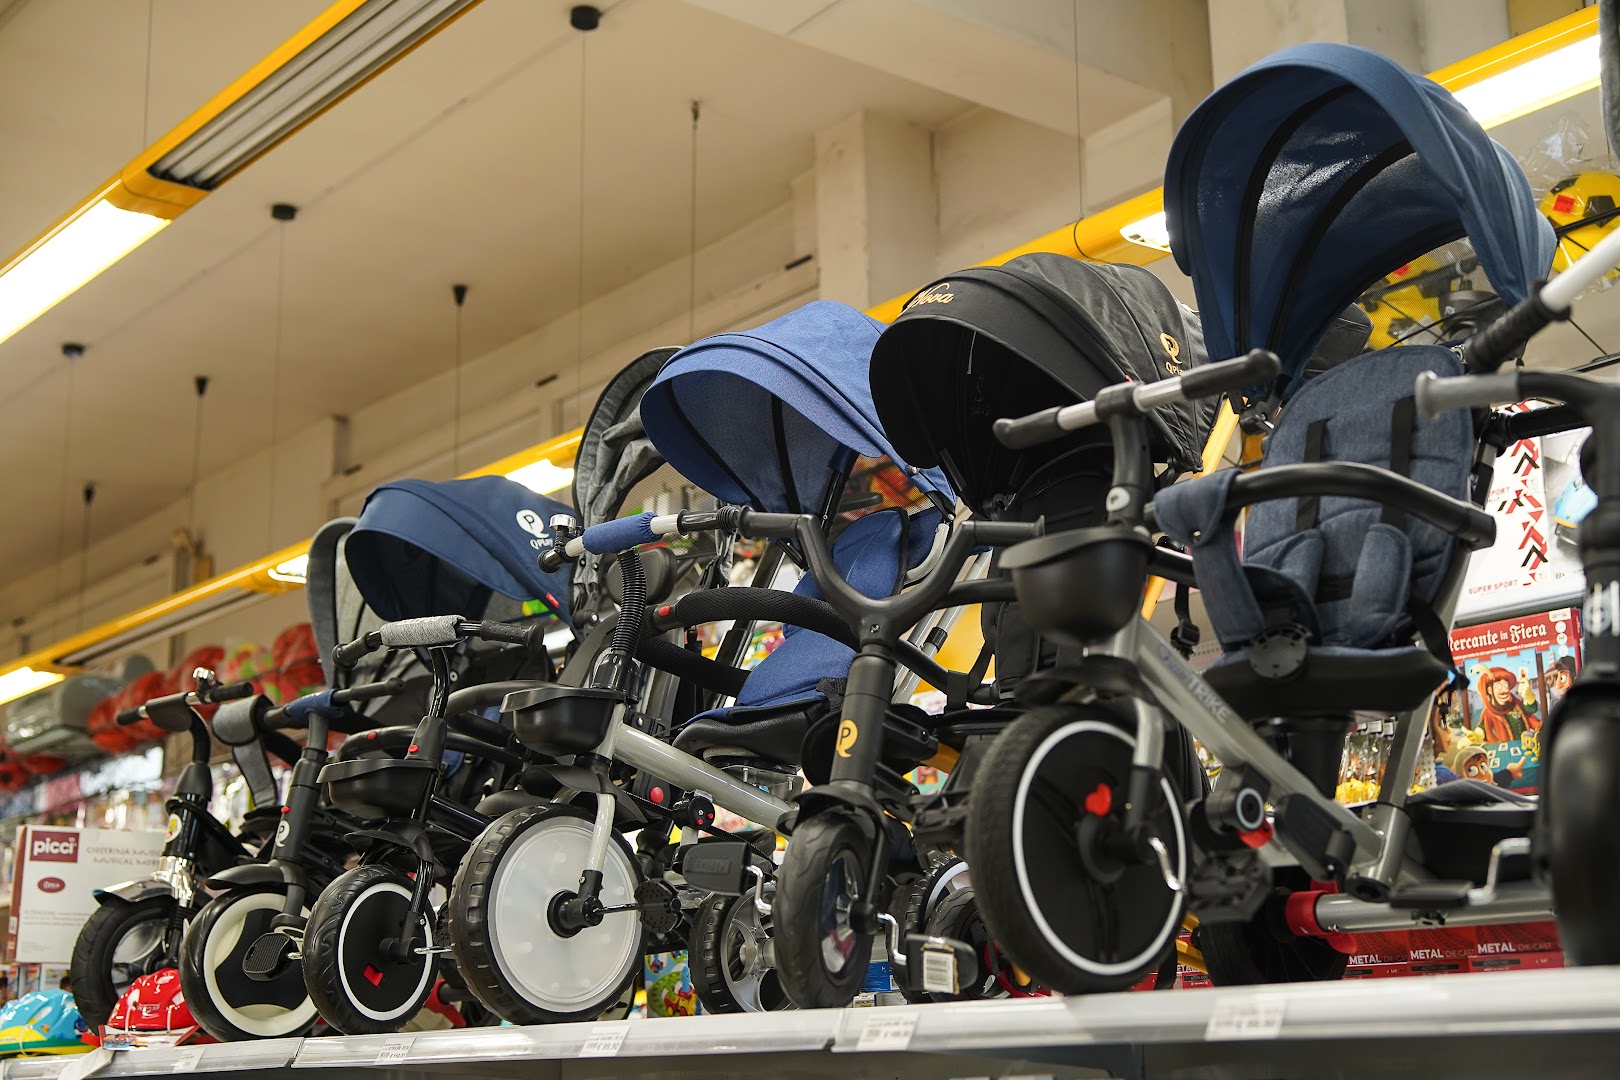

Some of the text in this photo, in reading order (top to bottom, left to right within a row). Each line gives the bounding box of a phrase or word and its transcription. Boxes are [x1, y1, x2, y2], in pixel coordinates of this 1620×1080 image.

[1165, 361, 1184, 376] QPla
[1468, 579, 1519, 595] SUPER SPORT
[1500, 630, 1509, 641] in
[1509, 622, 1547, 644] Fiera
[33, 837, 74, 856] picci
[1410, 948, 1475, 960] METAL DIE-CAST
[1477, 942, 1552, 954] METAL DIE-CAST
[1349, 954, 1408, 965] METAL DIE-CAS
